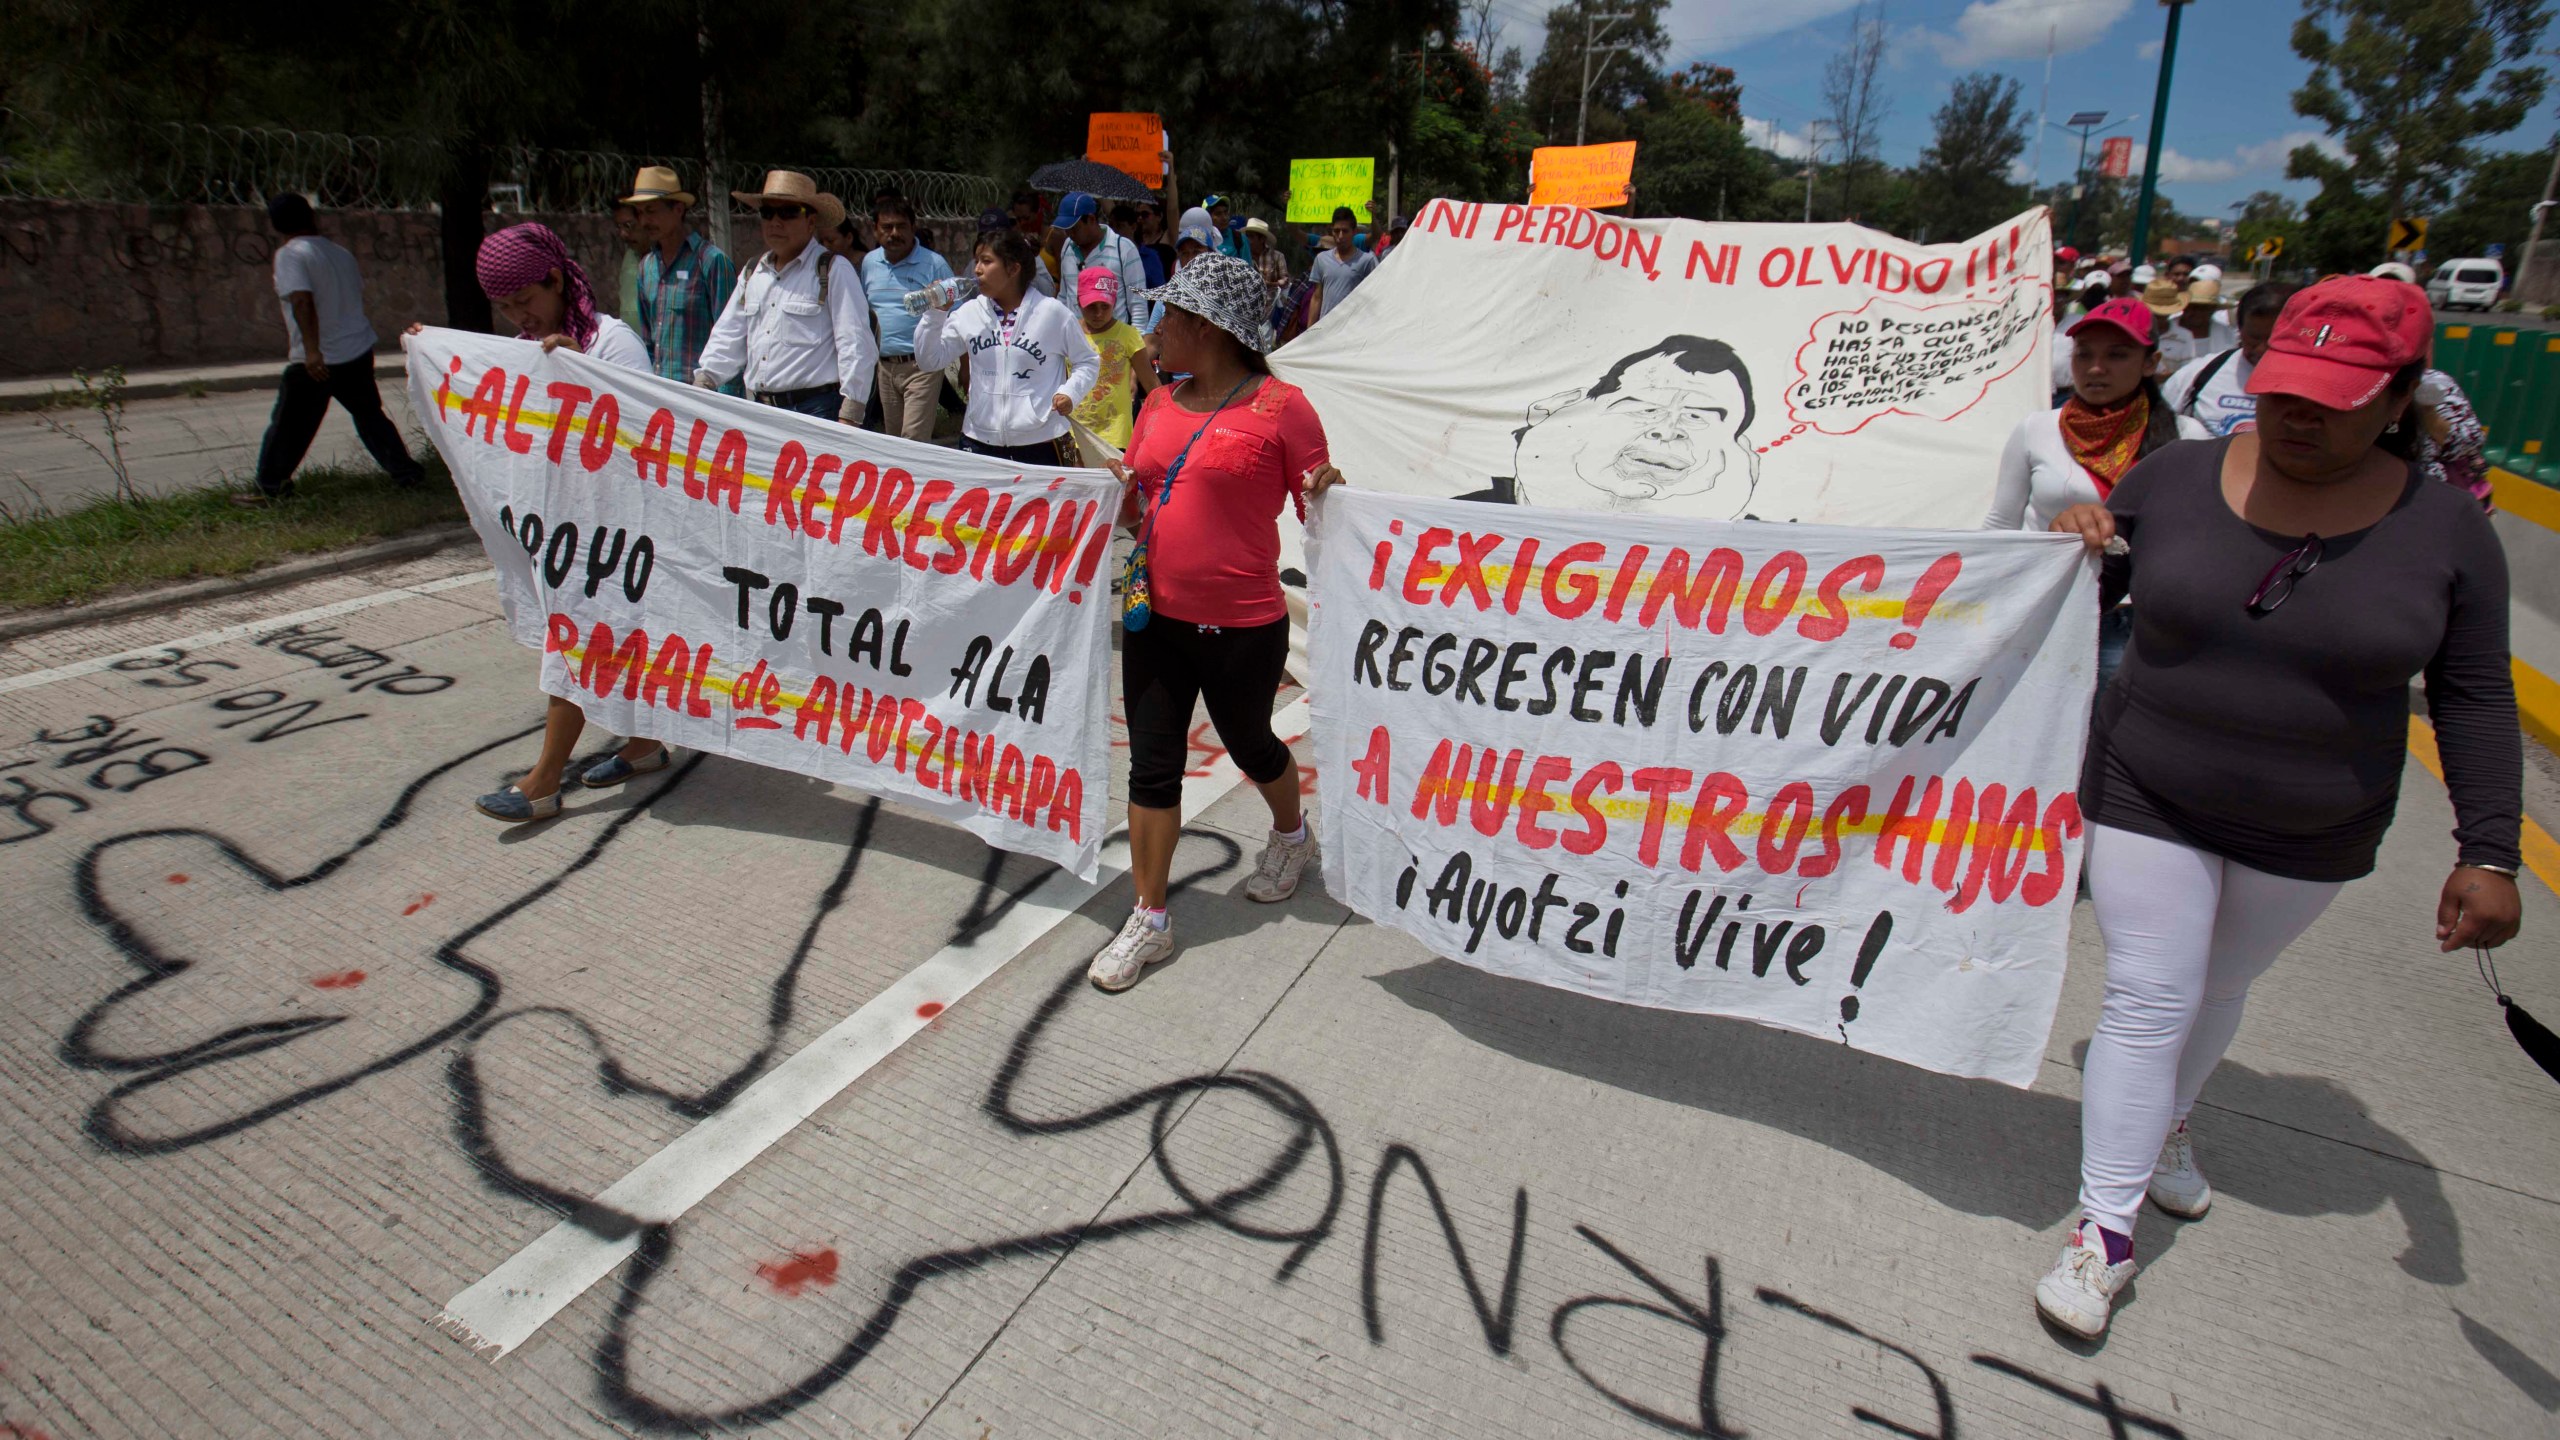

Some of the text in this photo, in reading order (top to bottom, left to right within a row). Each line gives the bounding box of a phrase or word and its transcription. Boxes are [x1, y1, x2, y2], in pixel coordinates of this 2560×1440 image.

[1684, 240, 1742, 285] NI
[1758, 243, 1954, 295] OLVIDO
[1827, 336, 1905, 354] HASTA
[1923, 331, 1969, 349] QUE
[1838, 318, 1869, 335] NO
[1818, 360, 1882, 382] LOGRE
[1824, 352, 1871, 368] HAGA
[1943, 372, 1967, 385] DE
[1973, 360, 1999, 376] SU
[1797, 382, 1812, 397] A
[1820, 379, 1849, 397] LOS
[722, 565, 913, 678] TOTAL
[1353, 618, 1982, 748] REGRESEN CON VIDA
[731, 658, 783, 717] de
[793, 675, 1083, 845] AYOTZINAPA
[1352, 725, 1391, 806] A
[1409, 737, 1871, 878] NUESTROS
[1873, 774, 2084, 914] HIJOS
[1395, 850, 1630, 959] ¡Ayotzi
